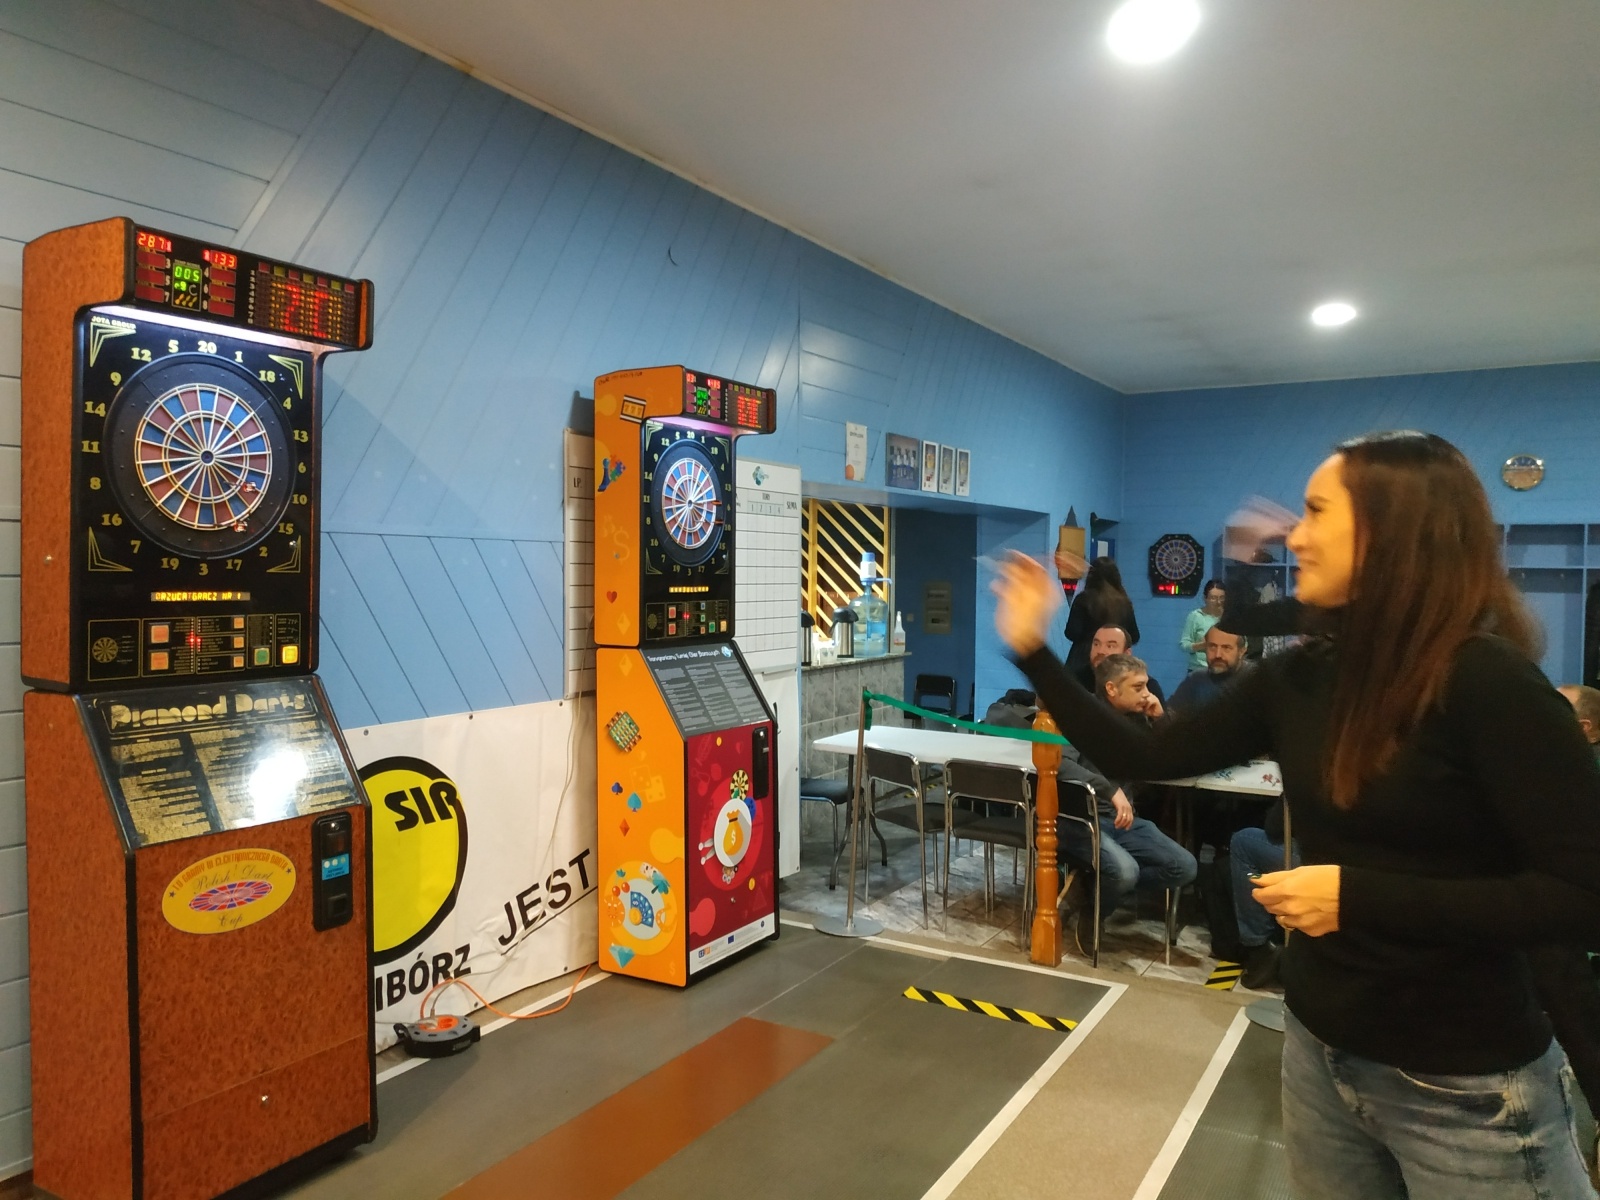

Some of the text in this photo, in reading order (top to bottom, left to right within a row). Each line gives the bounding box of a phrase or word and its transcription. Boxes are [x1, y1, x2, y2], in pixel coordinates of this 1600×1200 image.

[138, 232, 165, 250] 287
[166, 258, 171, 269] 3
[214, 253, 235, 268] 133
[174, 266, 200, 282] 005
[204, 267, 209, 278] 4
[166, 275, 171, 286] 5
[203, 284, 208, 294] 6
[164, 291, 170, 302] 7
[202, 300, 208, 310] 8
[92, 316, 136, 329] JOTA GROUP
[168, 340, 179, 353] 5
[197, 340, 217, 354] 20
[131, 347, 152, 362] 12
[235, 350, 243, 363] 1
[110, 372, 122, 386] 9
[259, 370, 275, 383] 18
[85, 401, 106, 417] 14
[283, 397, 292, 410] 4
[293, 430, 309, 442] 13
[675, 432, 680, 440] 5
[687, 431, 695, 439] 20
[82, 440, 100, 454] 11
[661, 438, 670, 446] 12
[711, 447, 718, 455] 18
[654, 453, 658, 462] 9
[298, 463, 306, 473] 6
[644, 472, 652, 481] 14
[90, 477, 101, 490] 8
[725, 483, 731, 492] 13
[292, 494, 308, 505] 10
[786, 501, 797, 510] SUMA
[101, 514, 122, 526] 16
[278, 523, 294, 534] 15
[131, 540, 141, 554] 7
[650, 538, 658, 546] 16
[259, 547, 268, 557] 2
[161, 557, 179, 570] 19
[226, 559, 242, 571] 17
[661, 555, 666, 563] 7
[199, 563, 209, 575] 3
[235, 692, 305, 713] Darts
[498, 848, 590, 946] JEST
